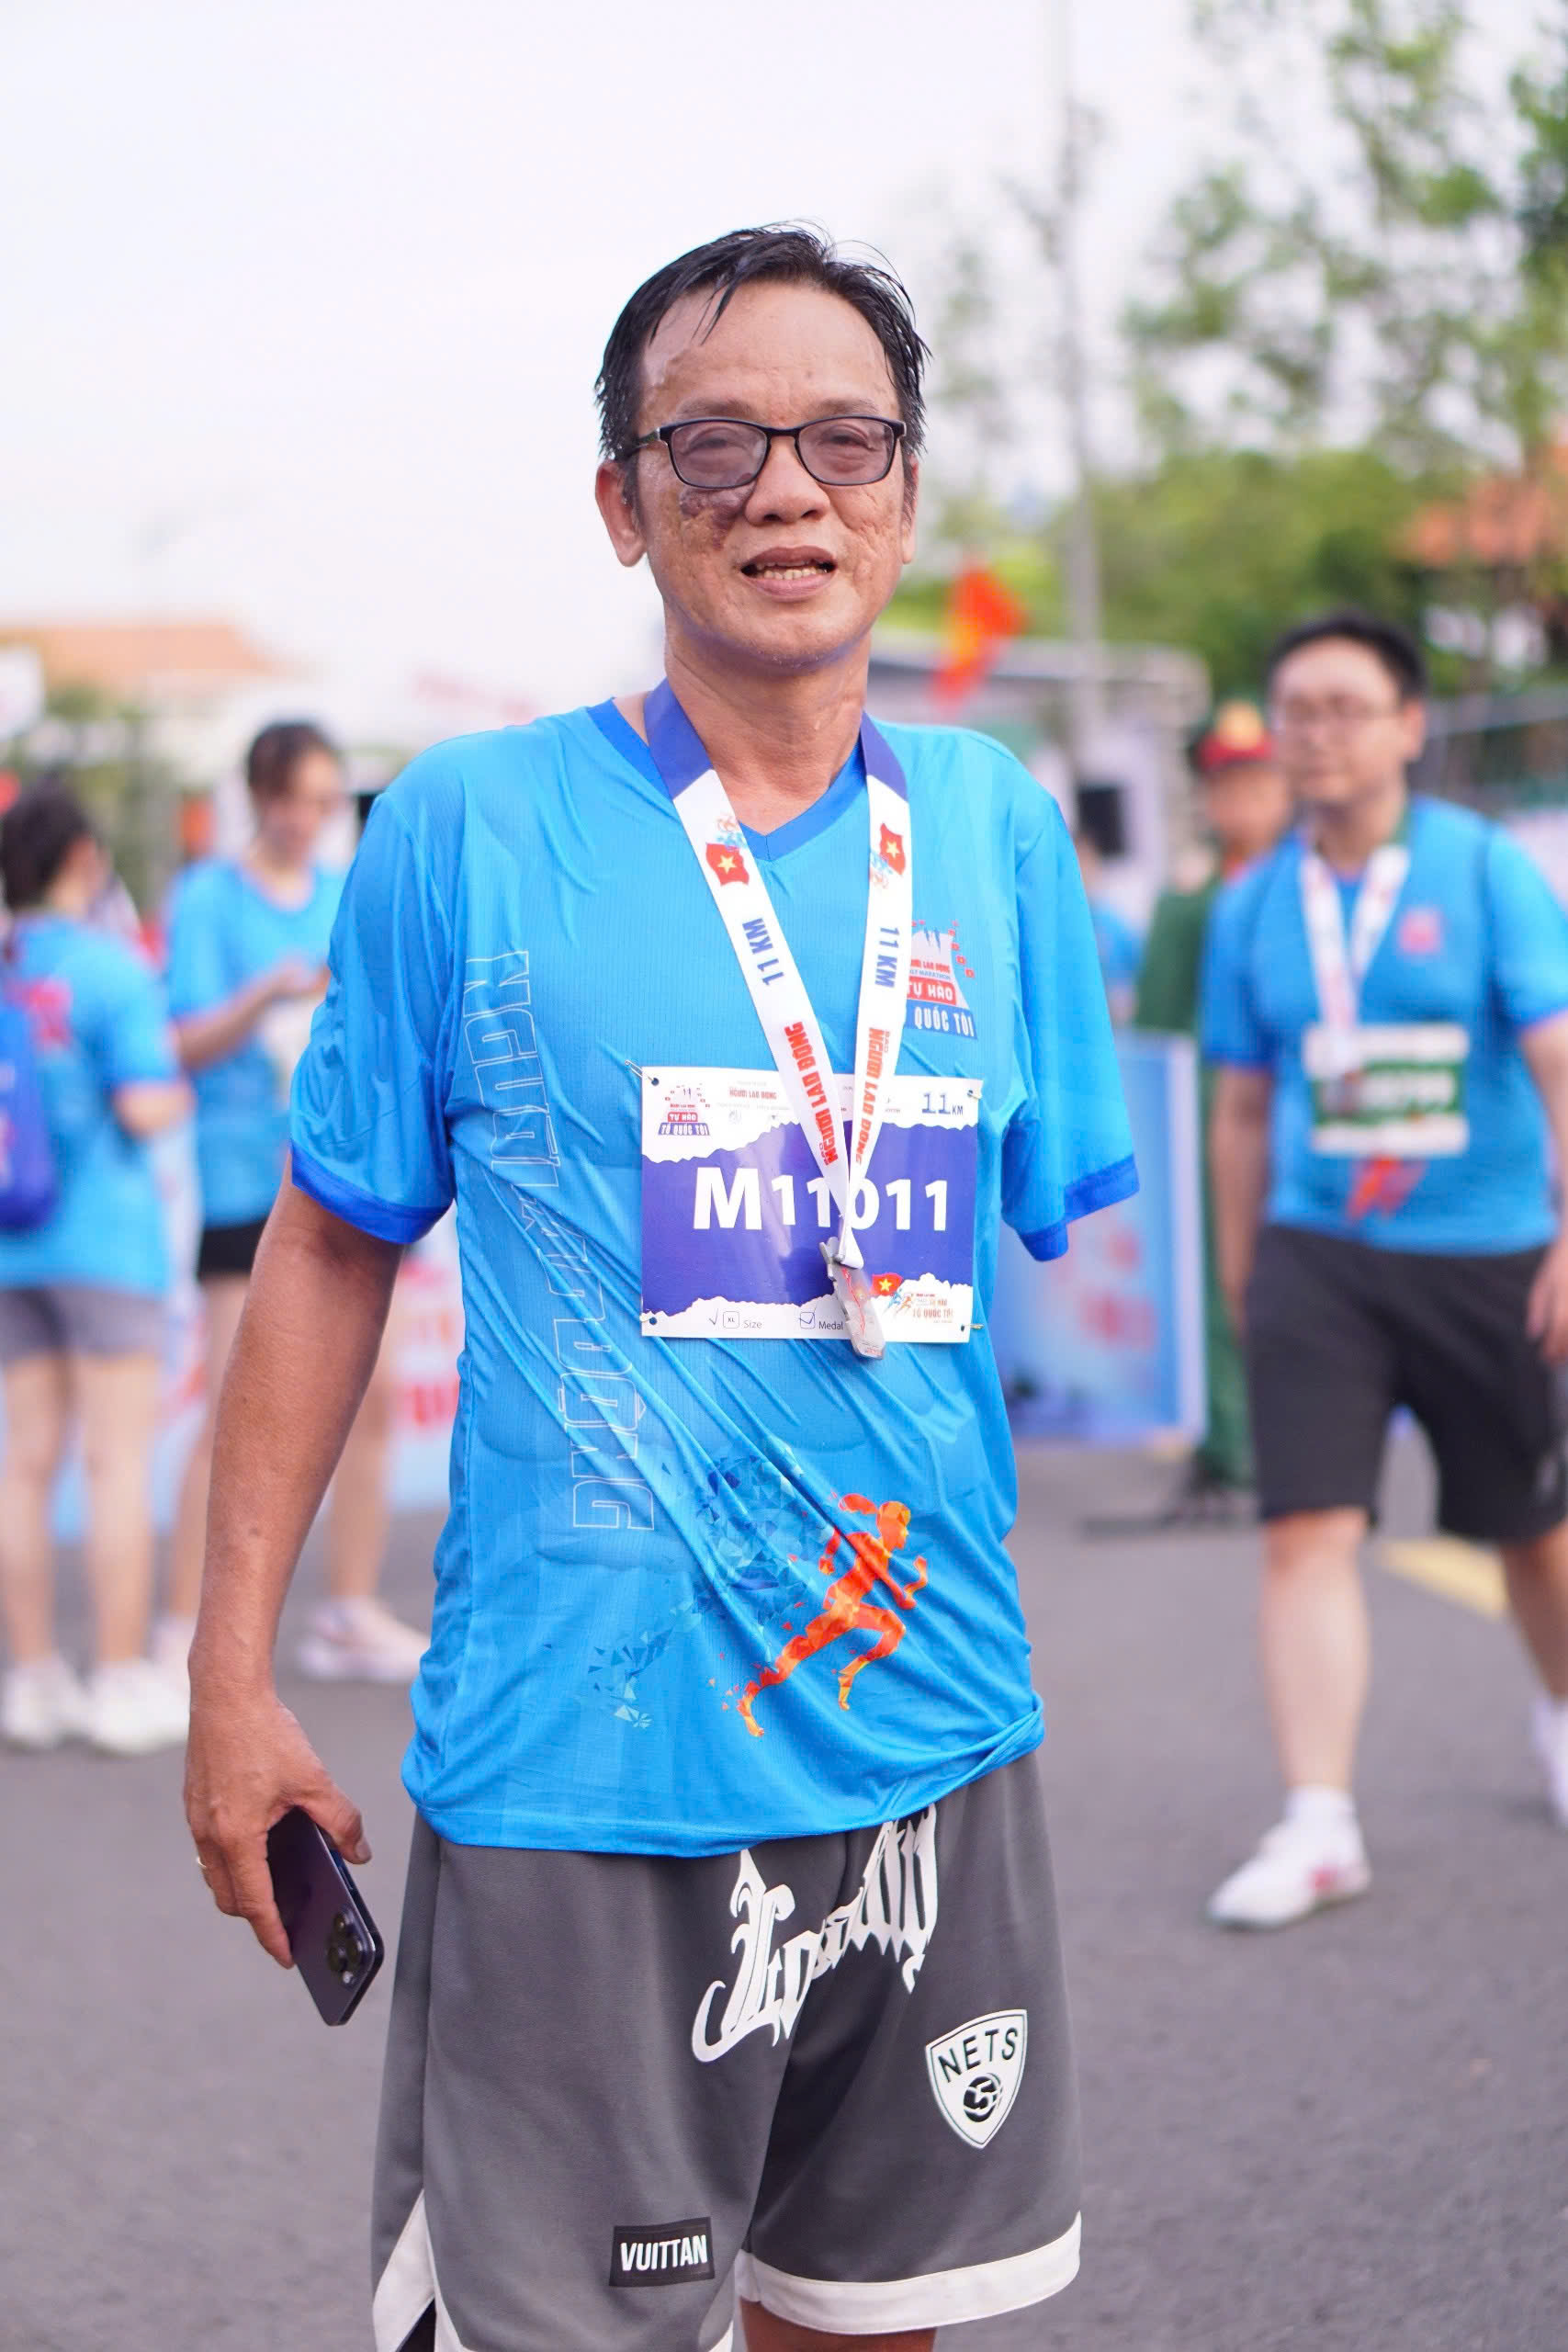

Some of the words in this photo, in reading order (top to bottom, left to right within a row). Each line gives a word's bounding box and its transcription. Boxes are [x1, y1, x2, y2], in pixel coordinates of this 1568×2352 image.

[742, 918, 773, 955] KM
[879, 927, 900, 948] 11
[757, 958, 784, 986] 11
[874, 954, 898, 988] KM
[802, 1070, 828, 1108] LAO
[862, 1080, 878, 1115] LAO
[694, 1167, 947, 1230] M11011
[743, 1319, 762, 1329] Size
[818, 1320, 844, 1330] Medal
[938, 2027, 1019, 2083] NETS
[620, 2234, 708, 2271] VUITTAN
